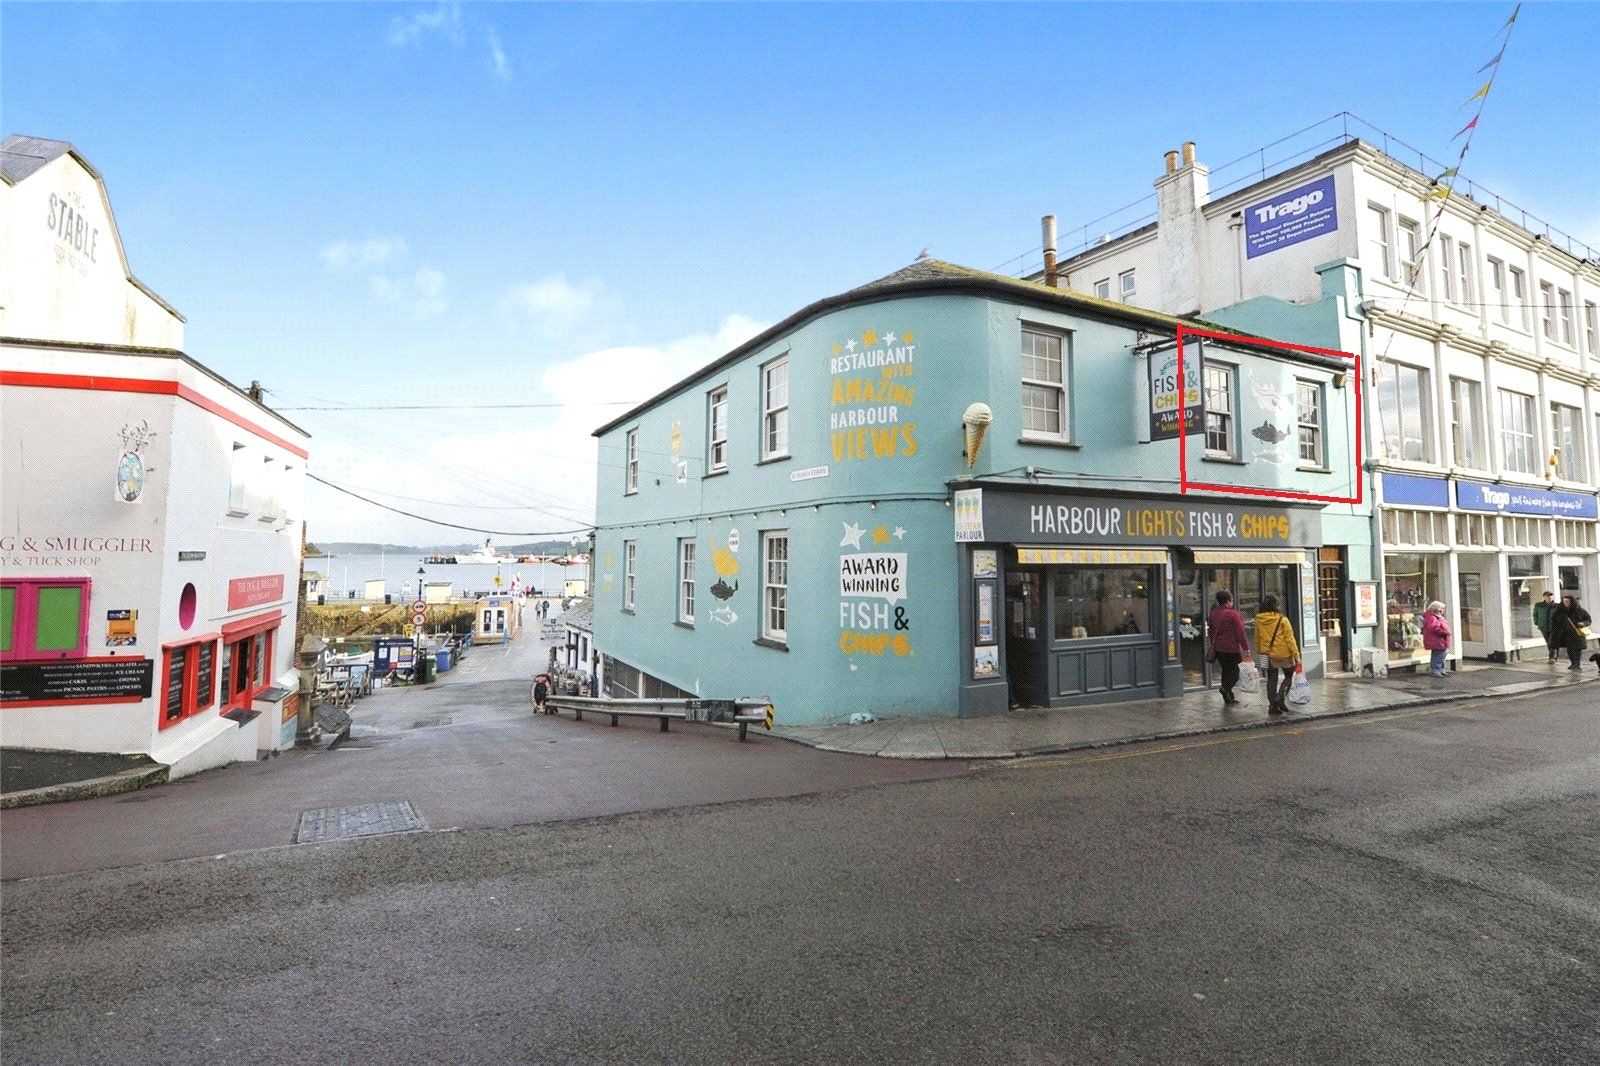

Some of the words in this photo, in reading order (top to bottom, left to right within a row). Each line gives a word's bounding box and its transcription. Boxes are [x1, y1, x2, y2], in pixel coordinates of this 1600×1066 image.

[1255, 190, 1324, 223] Trago
[47, 192, 98, 264] STABLE
[830, 345, 915, 374] RESTAURANT
[1188, 371, 1197, 388] &
[831, 378, 917, 407] AMAZING
[830, 406, 898, 429] HARBOUR
[1161, 420, 1194, 431] WINNNG
[830, 424, 917, 462] VIEWS
[1481, 486, 1510, 509] Trago
[1030, 505, 1121, 535] HARBOUR
[1126, 509, 1185, 537] LIGHTS
[1189, 511, 1222, 538] FISH
[1226, 512, 1237, 538] &
[1240, 514, 1290, 539] CHIPS
[22, 536, 38, 552] &
[44, 537, 153, 553] SMUGGLER
[956, 530, 983, 540] PARLOUR
[13, 556, 22, 566] &
[27, 556, 62, 566] TUCK
[66, 556, 101, 566] SHOP
[842, 557, 898, 575] AWARD
[842, 577, 900, 592] WINNING
[840, 602, 889, 629] FISH
[894, 606, 909, 630] &
[840, 631, 910, 656] CHIPS
